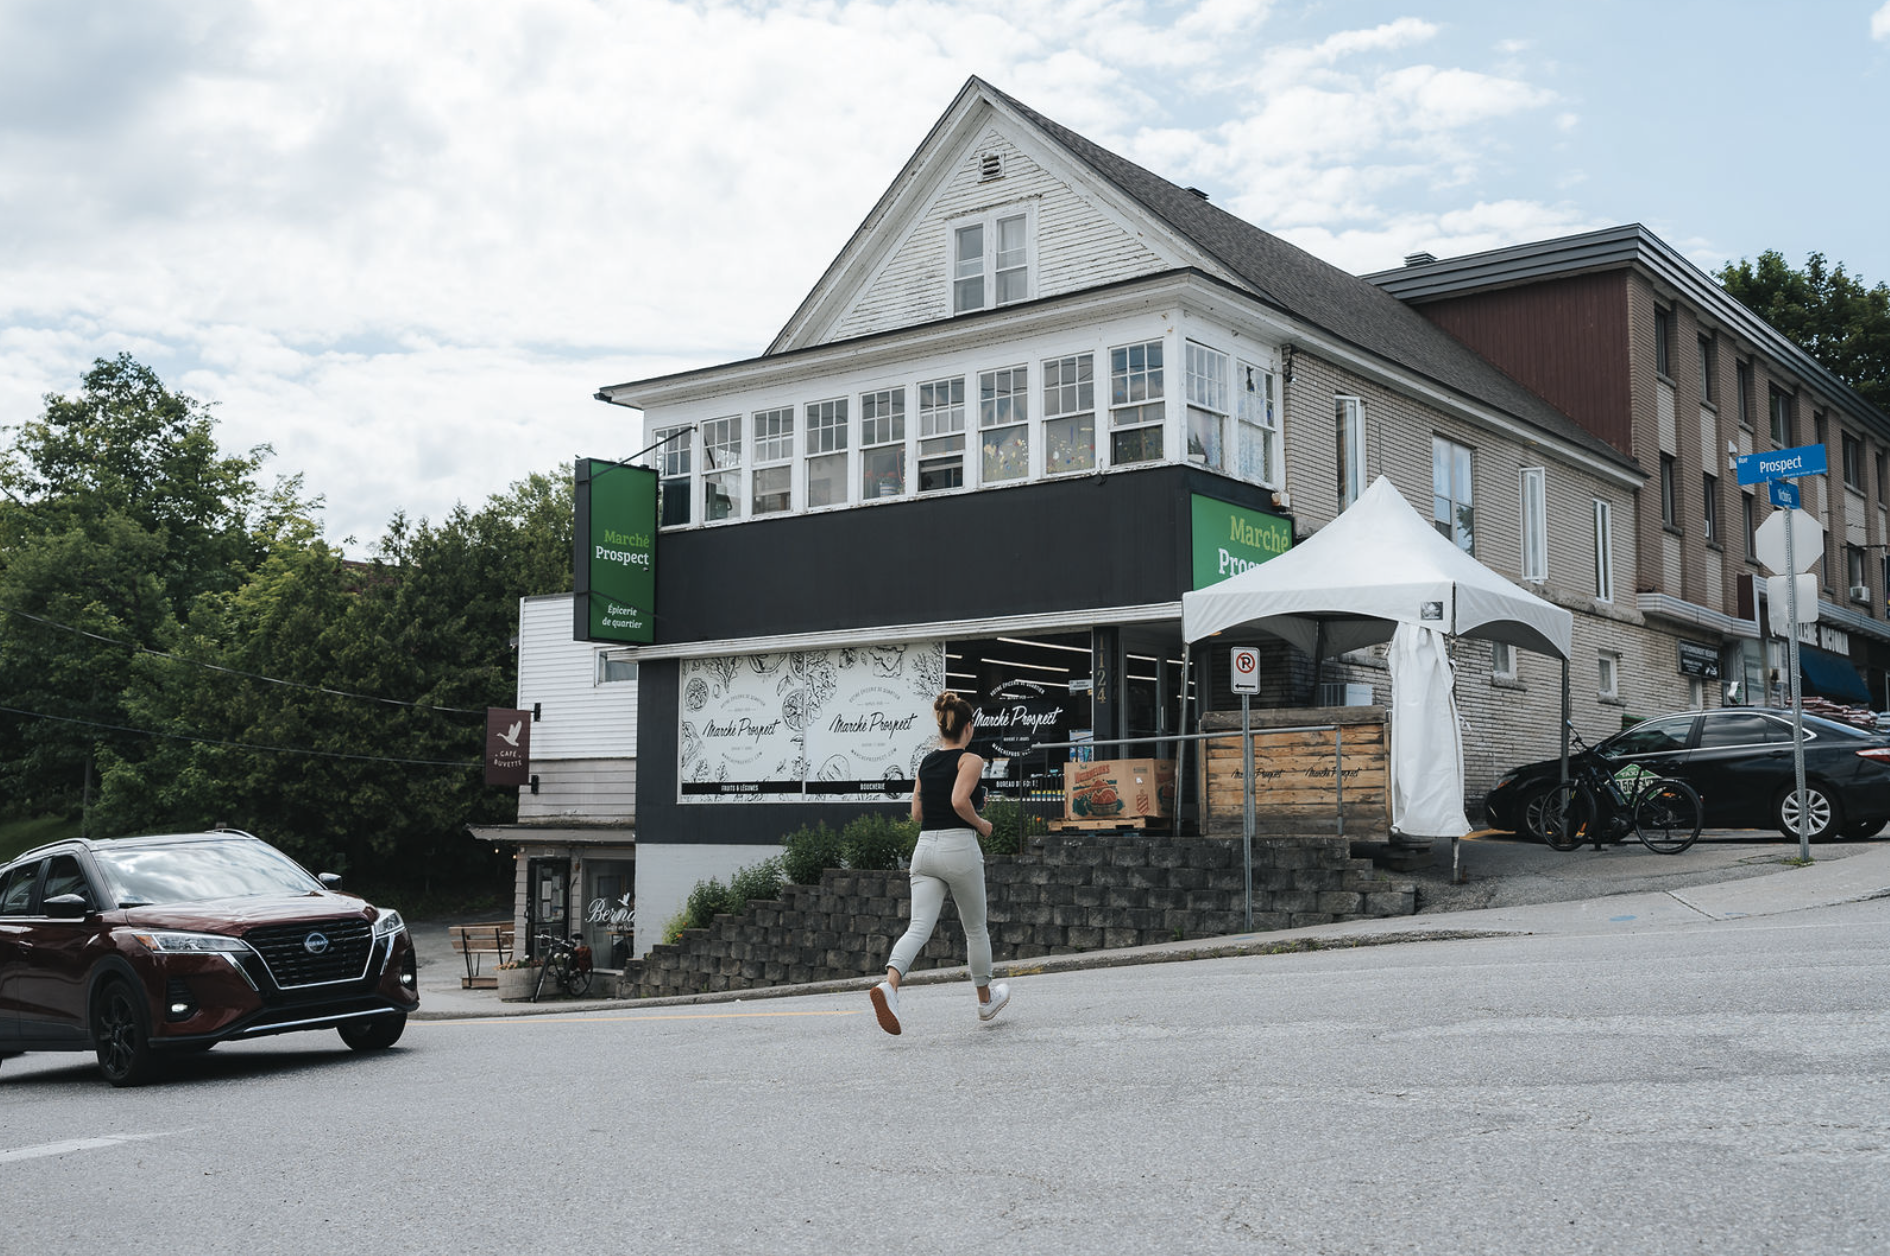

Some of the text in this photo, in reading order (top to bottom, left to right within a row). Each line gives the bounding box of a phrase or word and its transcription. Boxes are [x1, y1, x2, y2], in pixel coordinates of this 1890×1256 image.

[1759, 455, 1802, 474] Prospect
[603, 529, 650, 548] Marché
[1229, 515, 1289, 553] Marché
[595, 545, 650, 566] Prospect
[602, 616, 643, 629] de quartier
[702, 717, 782, 744] Marché Prospect
[828, 711, 918, 740] Marché Prospect
[972, 705, 1064, 735] Marché Prospect
